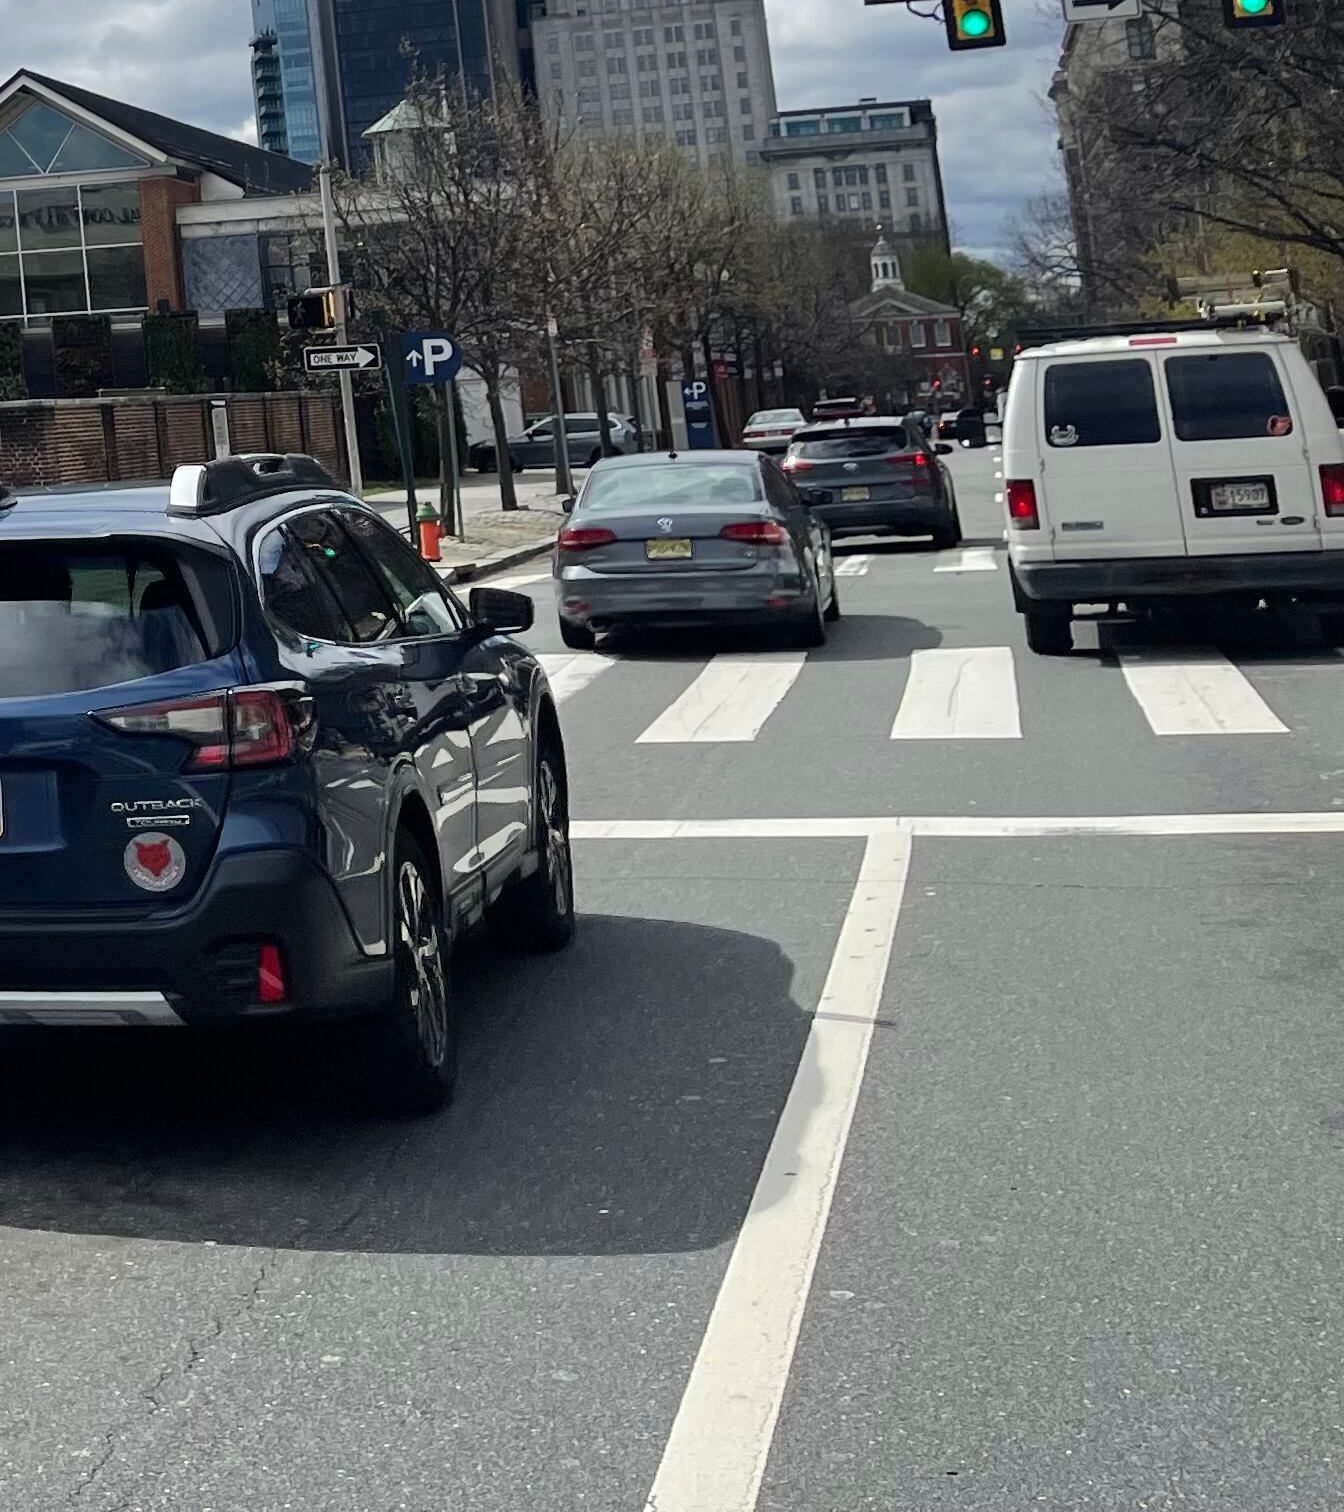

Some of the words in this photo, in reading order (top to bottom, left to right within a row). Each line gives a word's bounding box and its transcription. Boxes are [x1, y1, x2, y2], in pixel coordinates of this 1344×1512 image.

[313, 353, 332, 364] ONE
[336, 352, 357, 363] WAY
[422, 338, 453, 376] P
[692, 381, 707, 400] P
[110, 798, 203, 812] OUTBACK
